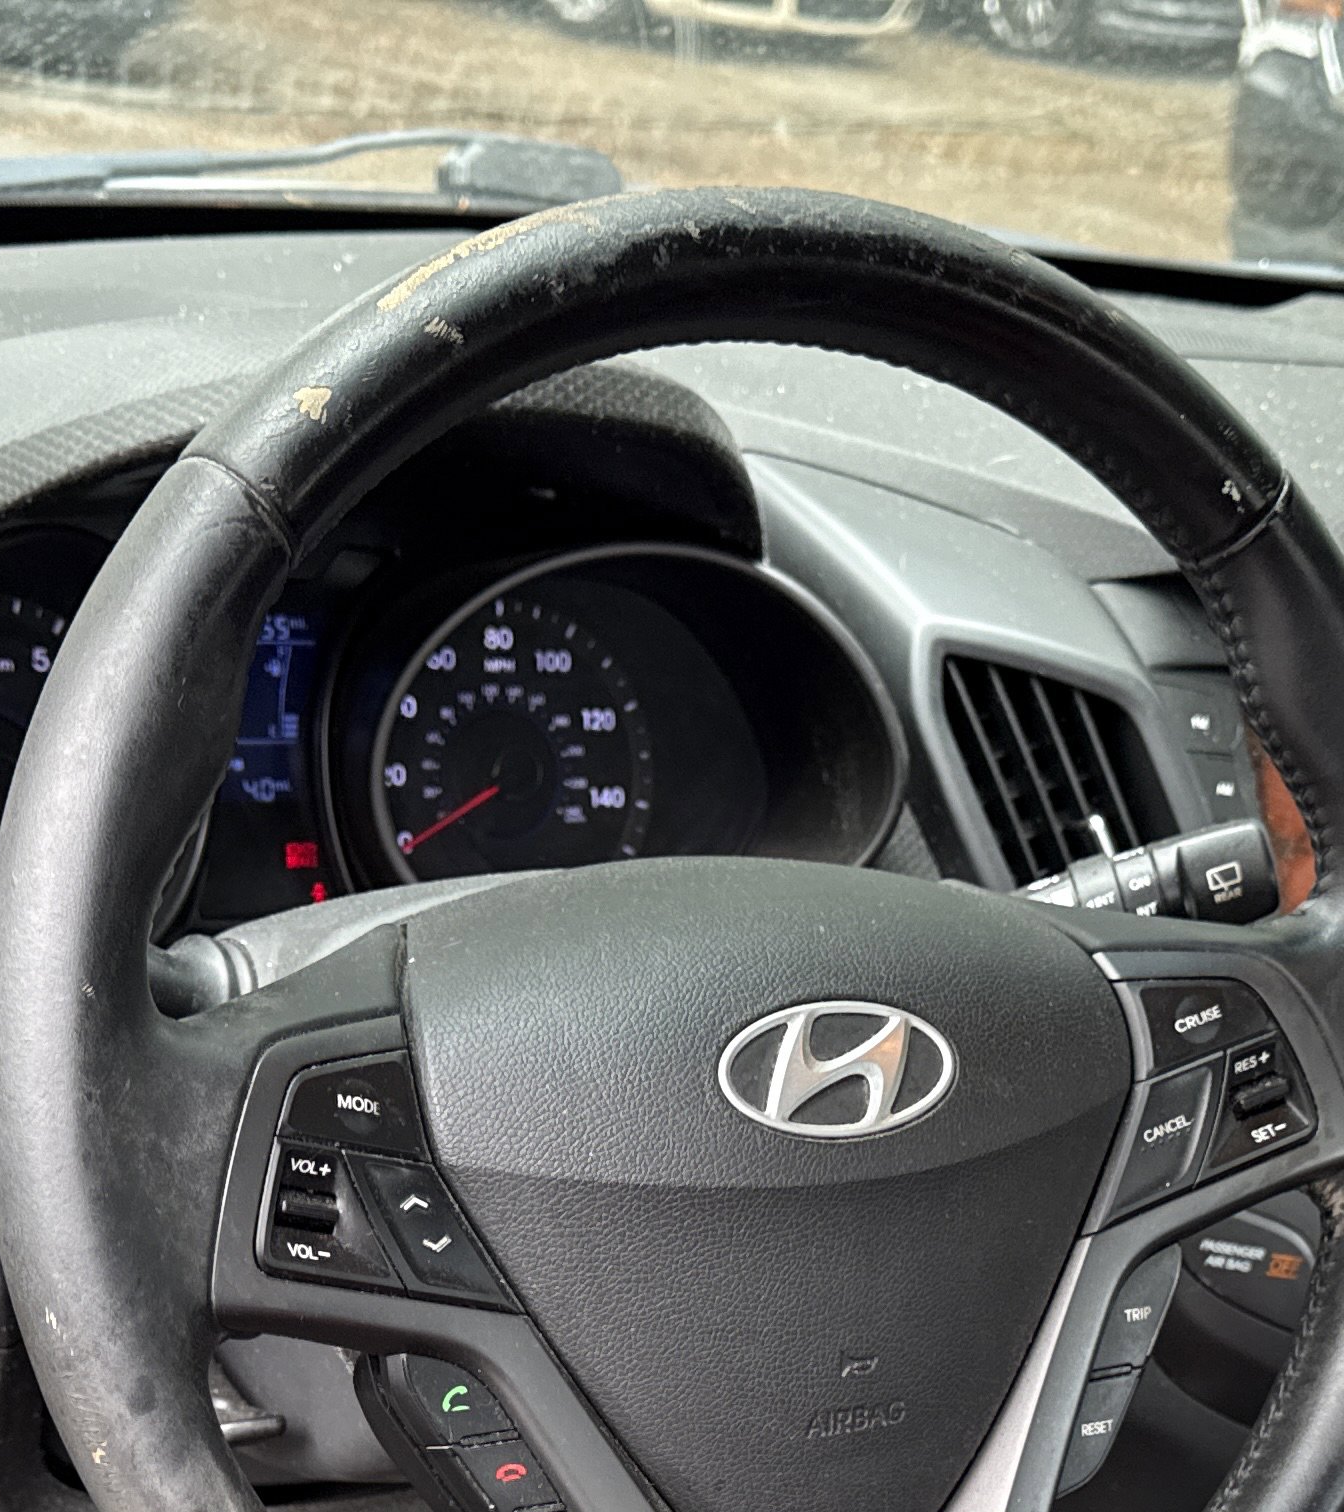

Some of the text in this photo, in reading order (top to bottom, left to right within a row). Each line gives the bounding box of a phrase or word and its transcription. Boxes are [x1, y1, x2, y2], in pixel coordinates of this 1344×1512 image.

[484, 625, 514, 650] 80
[31, 645, 51, 673] 5
[535, 649, 572, 673] 100
[581, 706, 617, 732] 120
[589, 786, 626, 809] 140
[1128, 874, 1151, 891] ON
[1213, 886, 1243, 905] REAR
[1174, 1004, 1223, 1034] CRUISE
[1143, 1114, 1194, 1143] CANCEL
[1124, 1305, 1152, 1323] TRIP
[807, 1401, 906, 1440] AIRBAG
[1081, 1418, 1114, 1438] RESET
